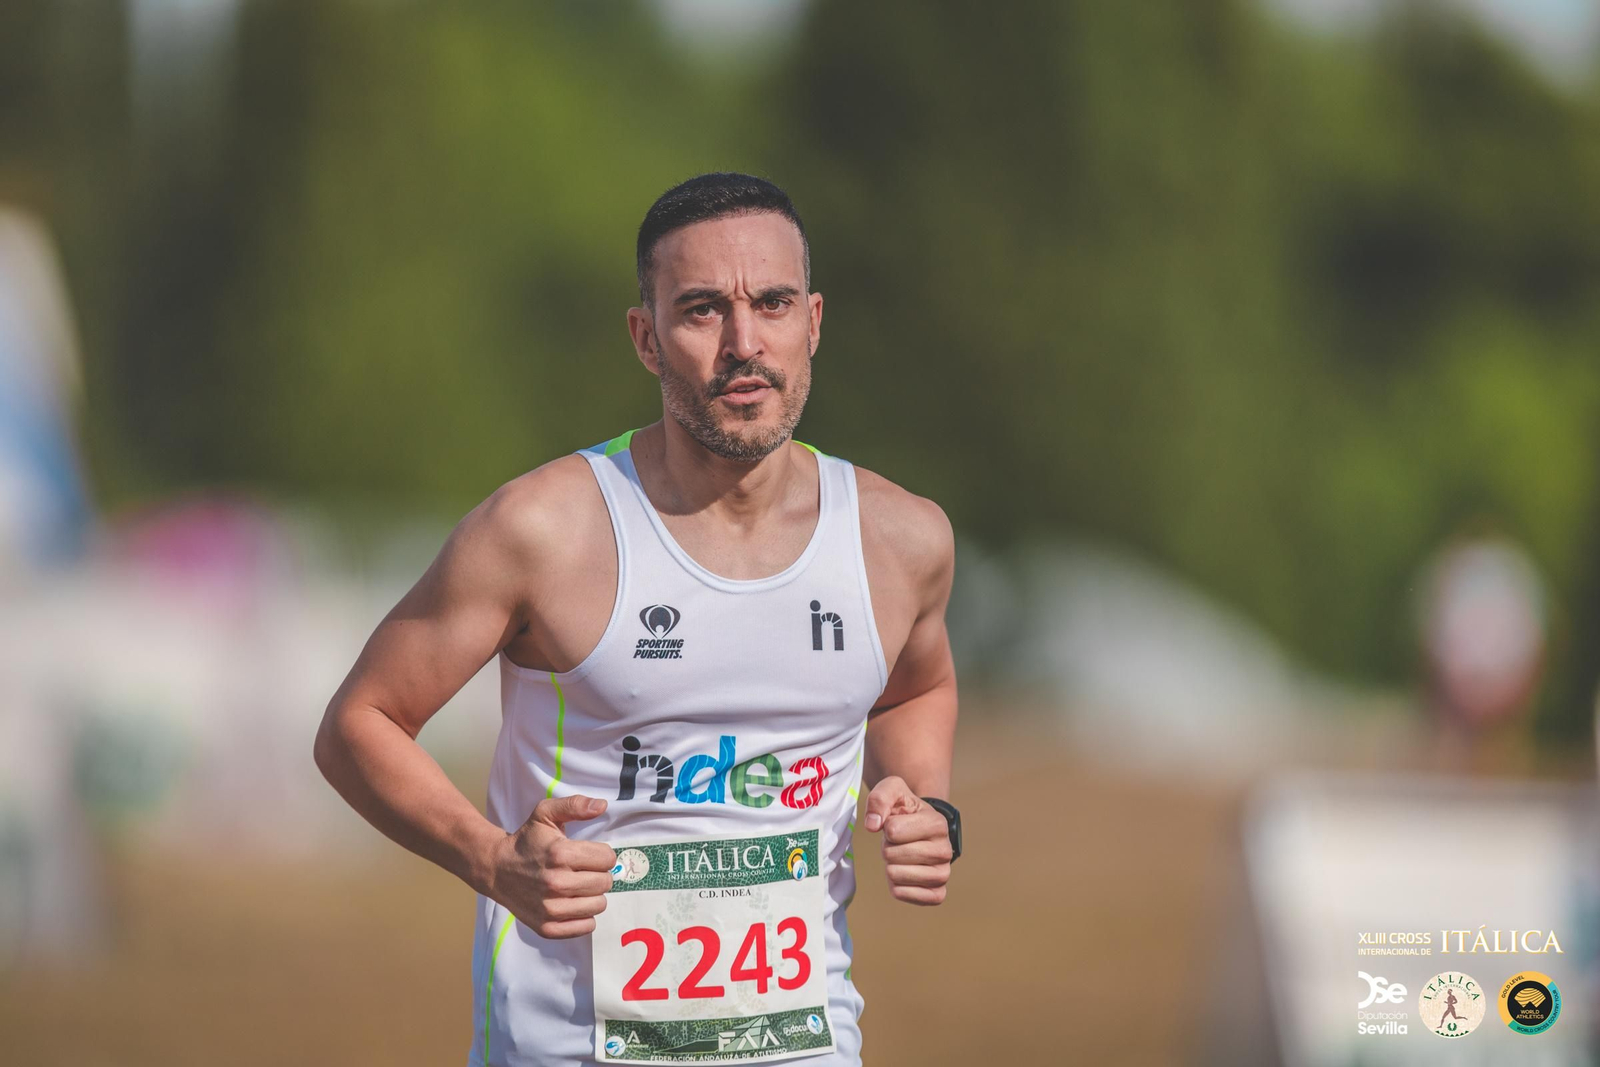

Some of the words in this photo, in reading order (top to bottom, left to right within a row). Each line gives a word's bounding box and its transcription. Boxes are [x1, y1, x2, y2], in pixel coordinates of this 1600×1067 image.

[635, 638, 684, 649] SPORTING
[633, 649, 683, 660] PURSUITS.
[616, 735, 829, 810] indea
[667, 844, 776, 873] ITÁLICA
[668, 872, 726, 881] INTERNATIONAL
[728, 870, 750, 879] CROSS
[698, 890, 719, 899] C.D.
[721, 888, 752, 898] INDEA
[620, 916, 812, 1002] 2243
[650, 1054, 696, 1063] FEDERACIÓN
[699, 1050, 739, 1062] ANDALUZA
[753, 1047, 788, 1059] ATLETISMO
